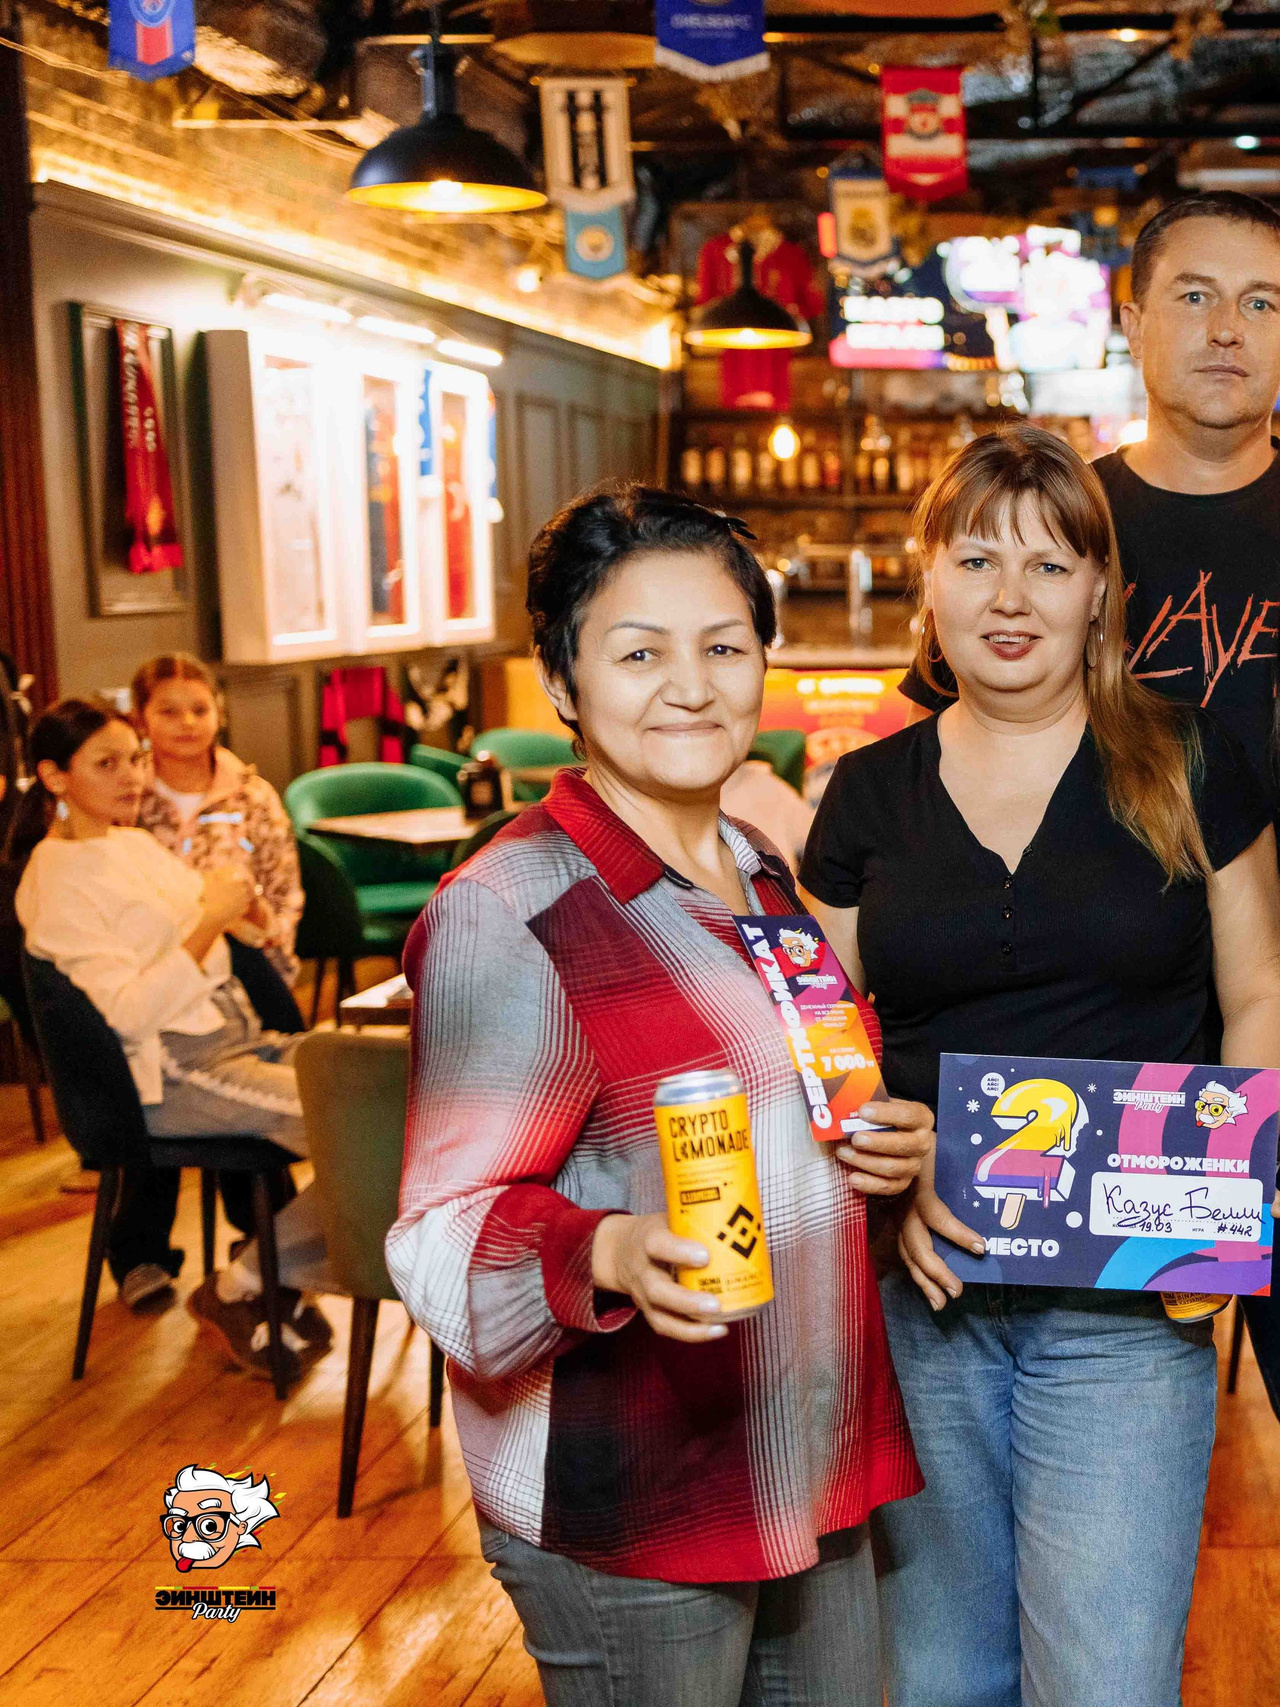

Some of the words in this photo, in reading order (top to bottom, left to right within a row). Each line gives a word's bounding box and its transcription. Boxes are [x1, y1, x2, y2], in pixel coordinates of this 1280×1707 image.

[741, 923, 833, 1130] СЕРТИФИКАТ
[834, 1053, 866, 1072] 000
[1134, 1100, 1166, 1113] Party
[669, 1109, 729, 1139] CRYPTO
[973, 1078, 1089, 1201] 2
[1107, 1153, 1250, 1173] ОТМОРОЖЕНКИ
[1103, 1182, 1174, 1228] Казус
[1139, 1219, 1173, 1234] 19.03
[981, 1236, 1060, 1258] МЕСТО
